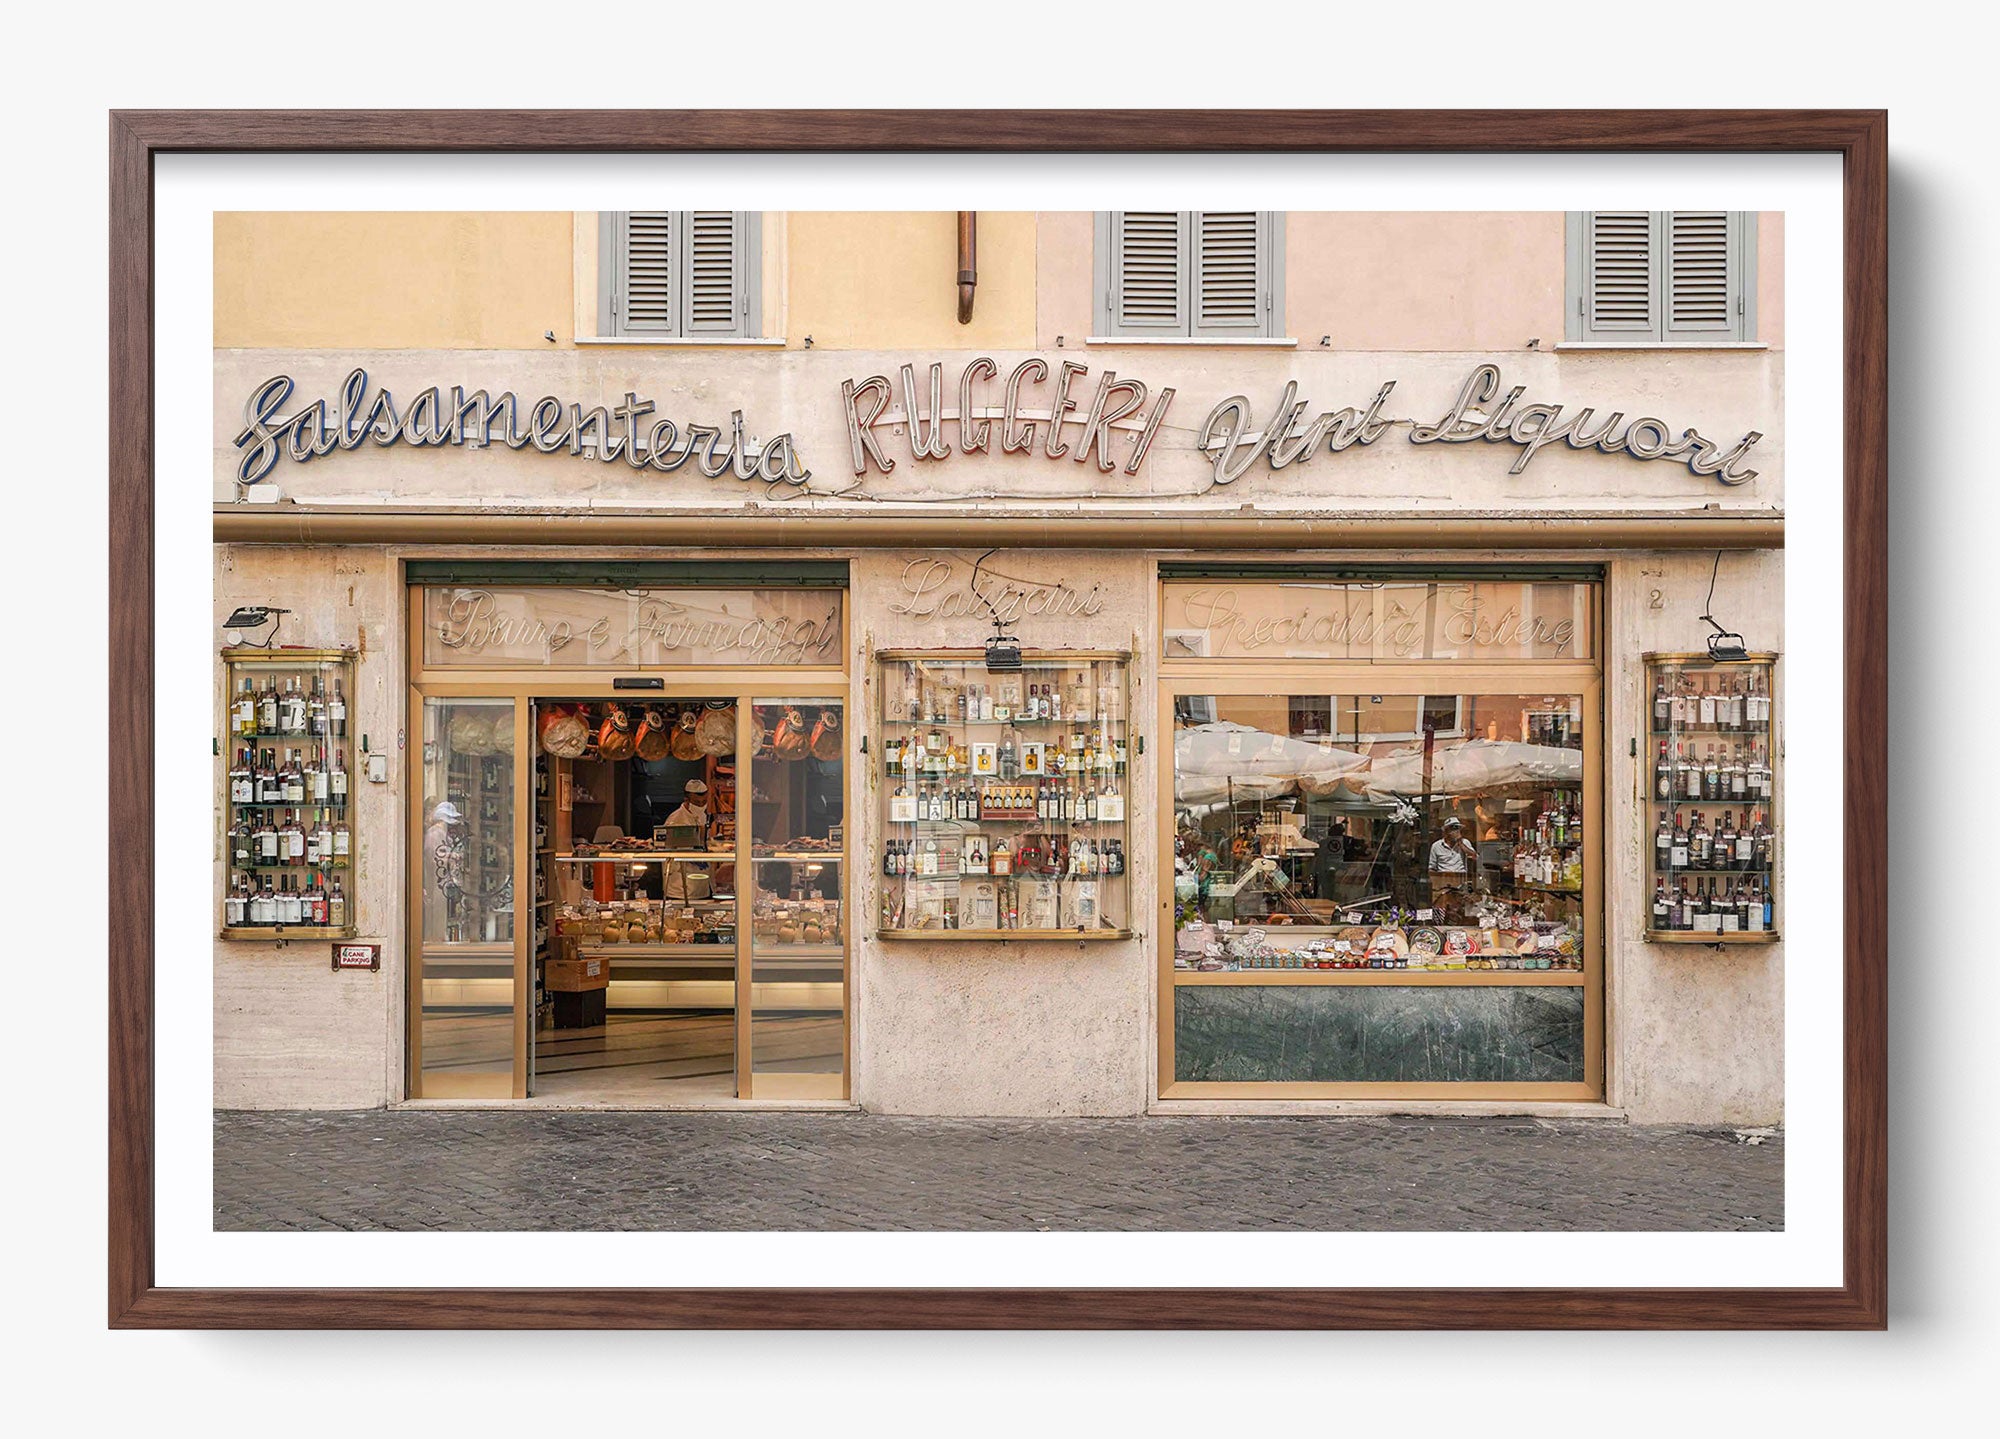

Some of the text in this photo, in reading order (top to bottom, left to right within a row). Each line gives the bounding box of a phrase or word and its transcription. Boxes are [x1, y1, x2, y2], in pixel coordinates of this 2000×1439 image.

[233, 367, 812, 485] Salsamenteria
[842, 358, 1176, 474] RUGGERI
[1198, 363, 1764, 486] Vini Liquori
[437, 590, 571, 650] Burro
[618, 598, 838, 664] Formaggi
[1650, 589, 1663, 609] 2
